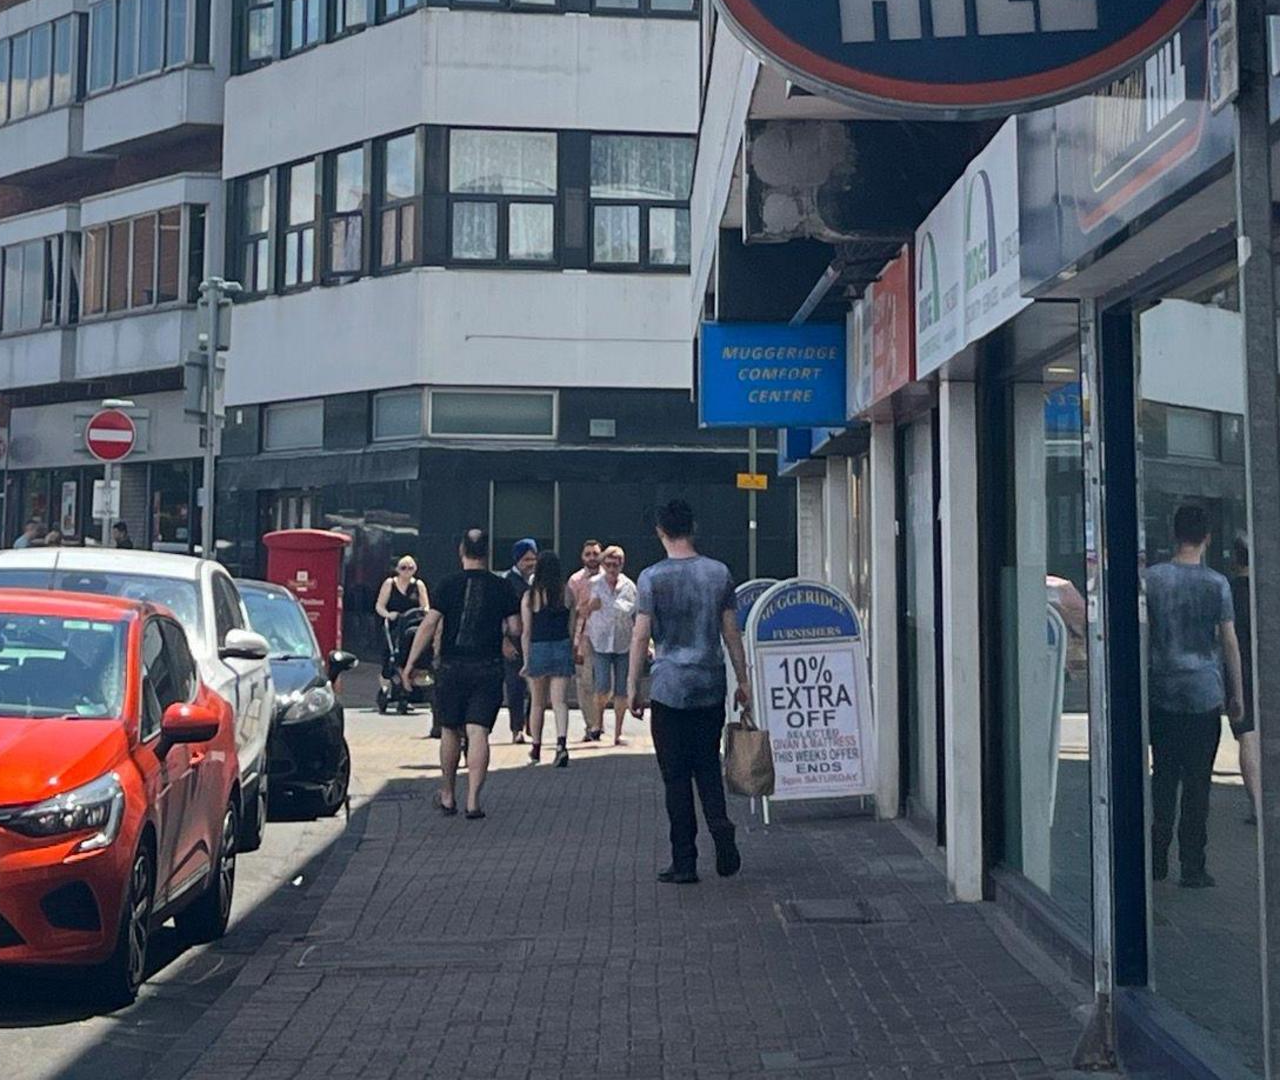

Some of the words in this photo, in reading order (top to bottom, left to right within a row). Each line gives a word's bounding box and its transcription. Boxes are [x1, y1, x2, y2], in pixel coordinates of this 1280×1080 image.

[722, 346, 838, 360] MUGGERIDGE
[738, 368, 822, 381] COMFORT
[748, 389, 813, 403] CENTRE
[773, 626, 842, 640] FURNISHERS
[779, 655, 833, 686] 10%
[771, 683, 852, 710] EXTRA
[786, 709, 837, 729] OFF
[774, 750, 794, 763] THIS
[796, 748, 828, 762] WEEKS
[829, 747, 859, 761] OFFER
[796, 761, 842, 774] ENDS
